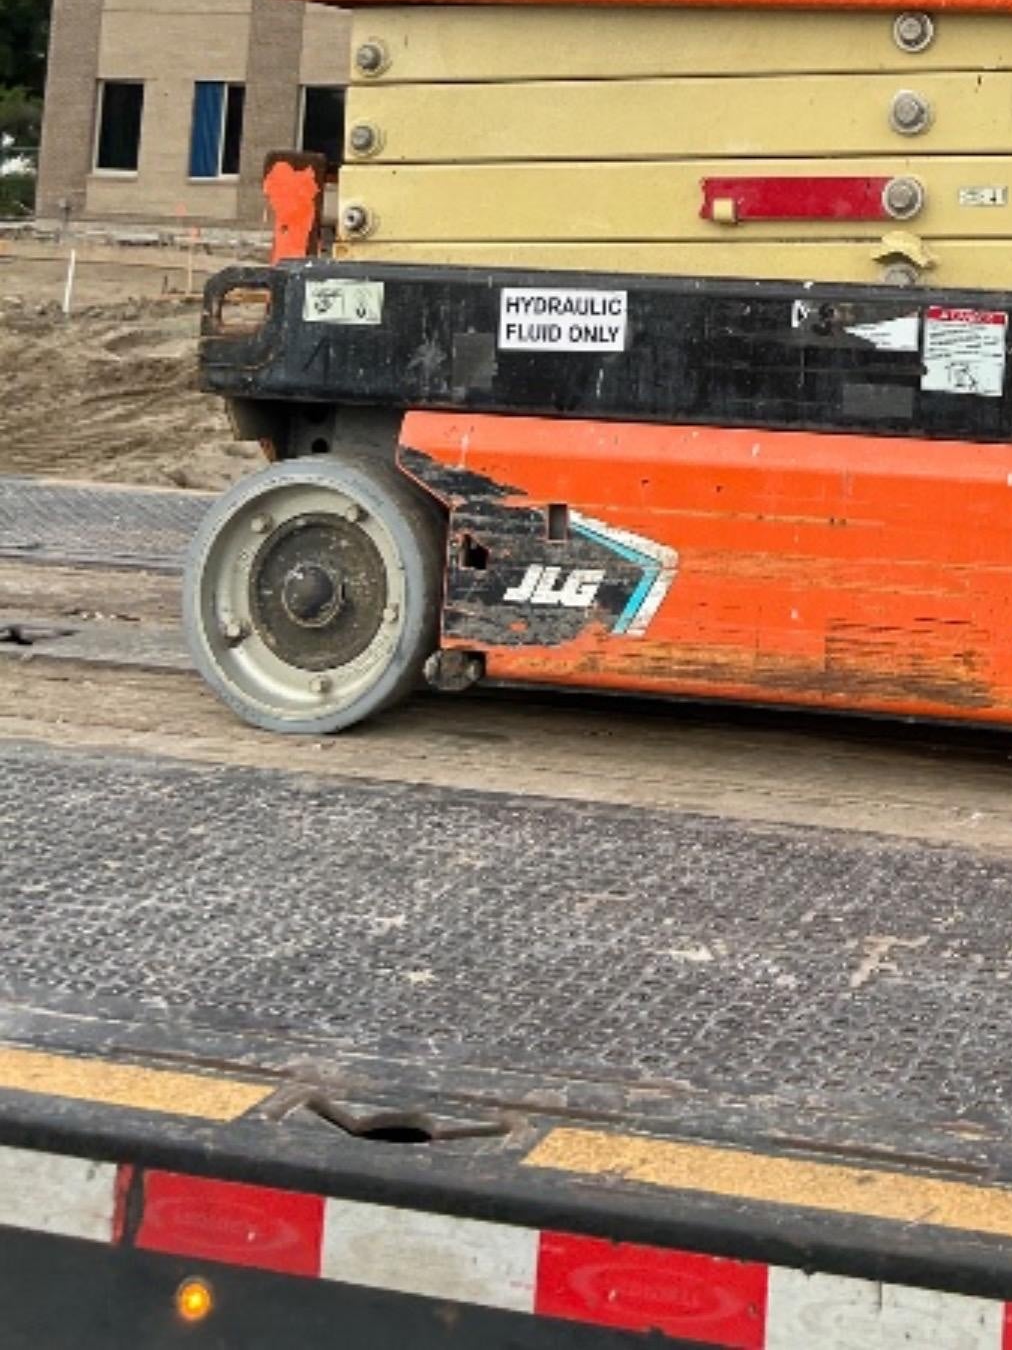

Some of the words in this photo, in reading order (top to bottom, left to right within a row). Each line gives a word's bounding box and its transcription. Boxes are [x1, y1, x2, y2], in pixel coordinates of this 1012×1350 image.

[505, 295, 623, 317] HYDRAULIC
[505, 323, 562, 344] FLUID
[568, 324, 621, 344] ONLY
[502, 563, 607, 608] JLG
